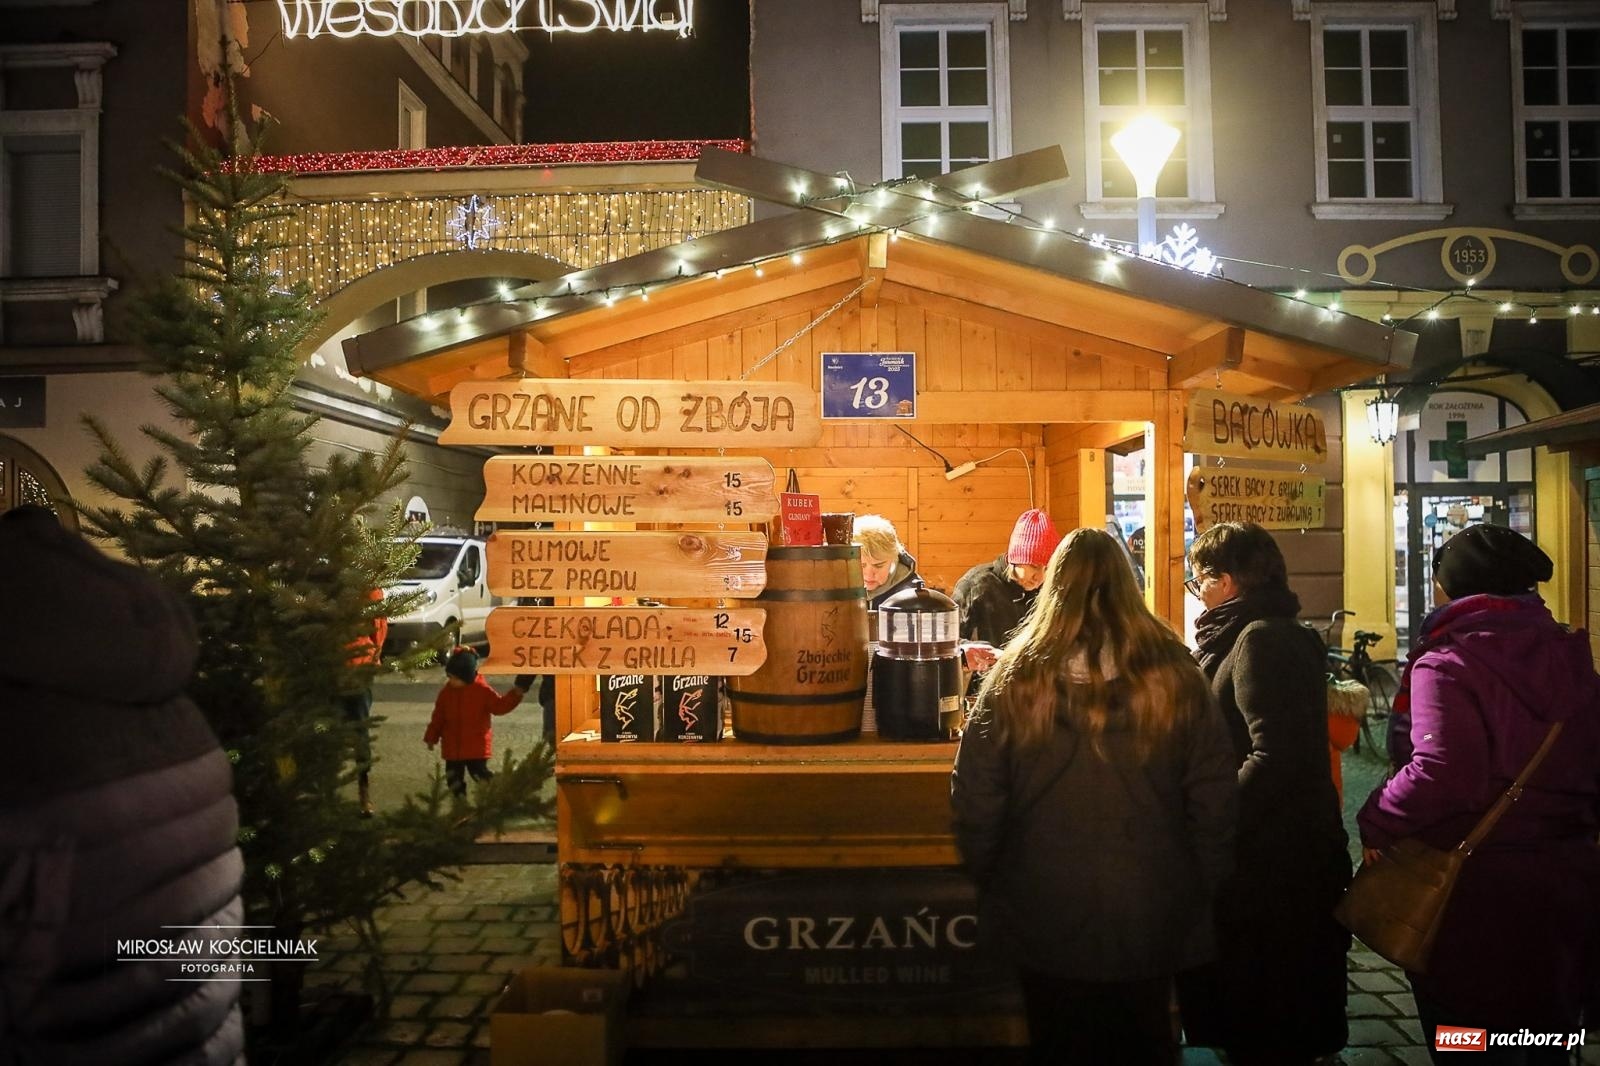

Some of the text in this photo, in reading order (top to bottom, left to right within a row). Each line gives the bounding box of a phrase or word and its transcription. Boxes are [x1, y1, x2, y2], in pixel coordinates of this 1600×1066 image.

[1454, 250, 1485, 263] 1953
[850, 377, 889, 409] 13
[468, 393, 595, 432] GRZANE
[616, 396, 661, 432] OD
[512, 463, 741, 488] KORZENNE 15
[1211, 475, 1240, 497] SEREK
[1245, 477, 1265, 497] BACY
[1270, 481, 1274, 496] Z
[512, 493, 743, 516] MALINOWE 15
[787, 498, 813, 508] KUBEK
[1211, 502, 1241, 525] SEREK
[1246, 505, 1267, 523] BACY
[1269, 507, 1274, 521] Z
[511, 540, 611, 564] RUMOWE
[511, 568, 637, 592] BEZ PRĄDU
[714, 613, 730, 629] 12
[734, 628, 752, 643] 15
[511, 646, 738, 670] SEREK Z GRILLA 7
[608, 674, 645, 691] Grzane
[672, 675, 709, 692] Grzane
[743, 907, 978, 950] GRZAŃC
[805, 964, 951, 985] MULLED WINE
